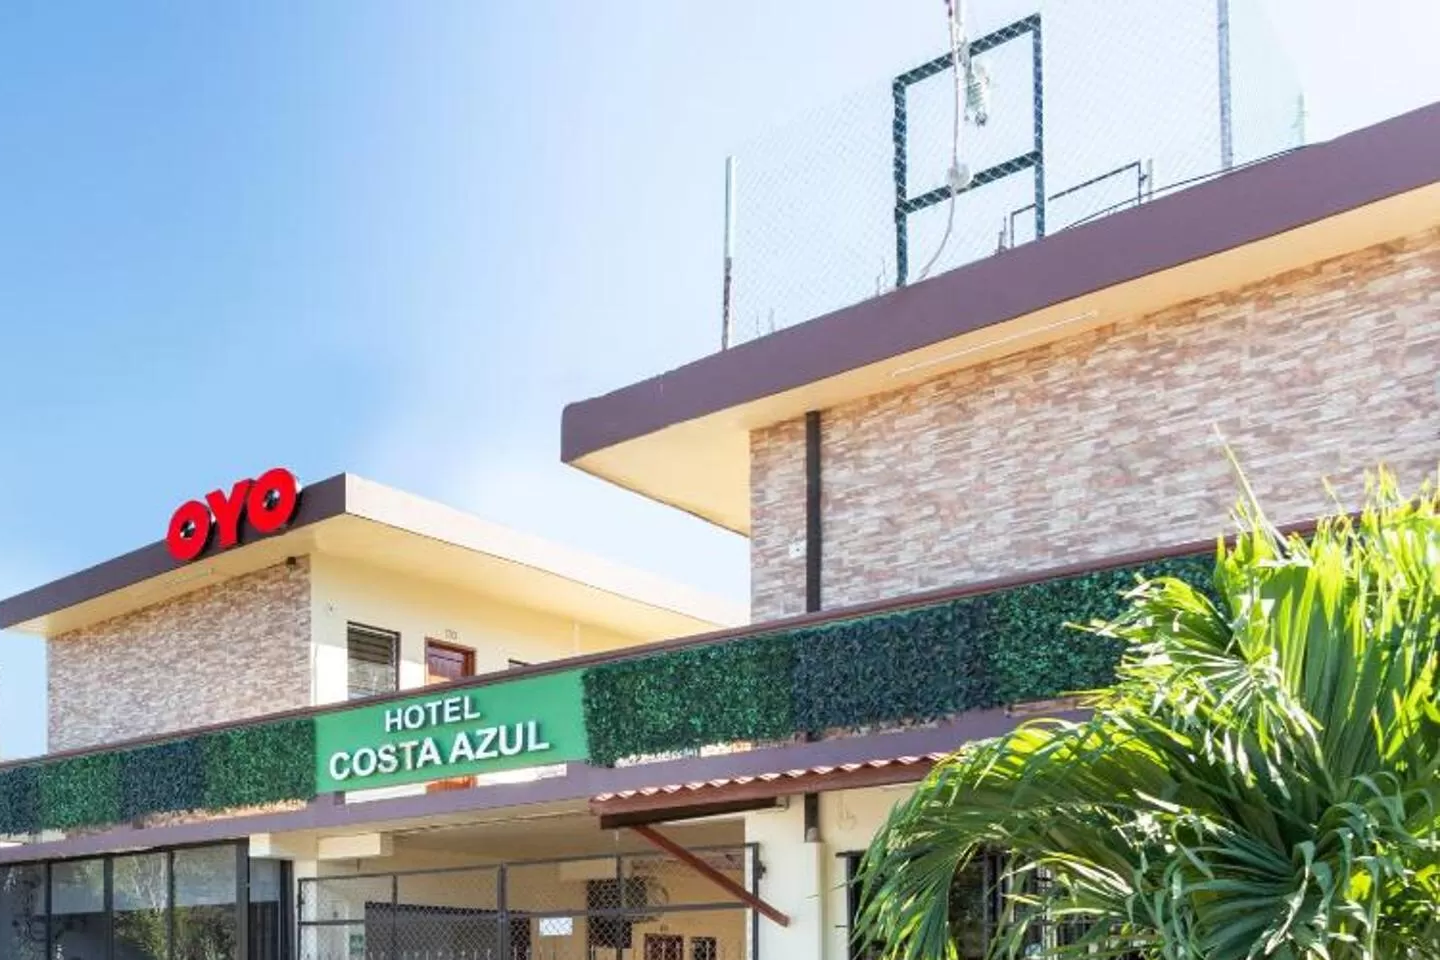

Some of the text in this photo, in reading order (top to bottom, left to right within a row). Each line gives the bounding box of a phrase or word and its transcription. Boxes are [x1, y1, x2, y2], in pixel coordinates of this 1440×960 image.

[165, 467, 298, 562] OYO
[384, 695, 481, 733] HOTEL
[329, 720, 550, 781] COSTA AZUL
